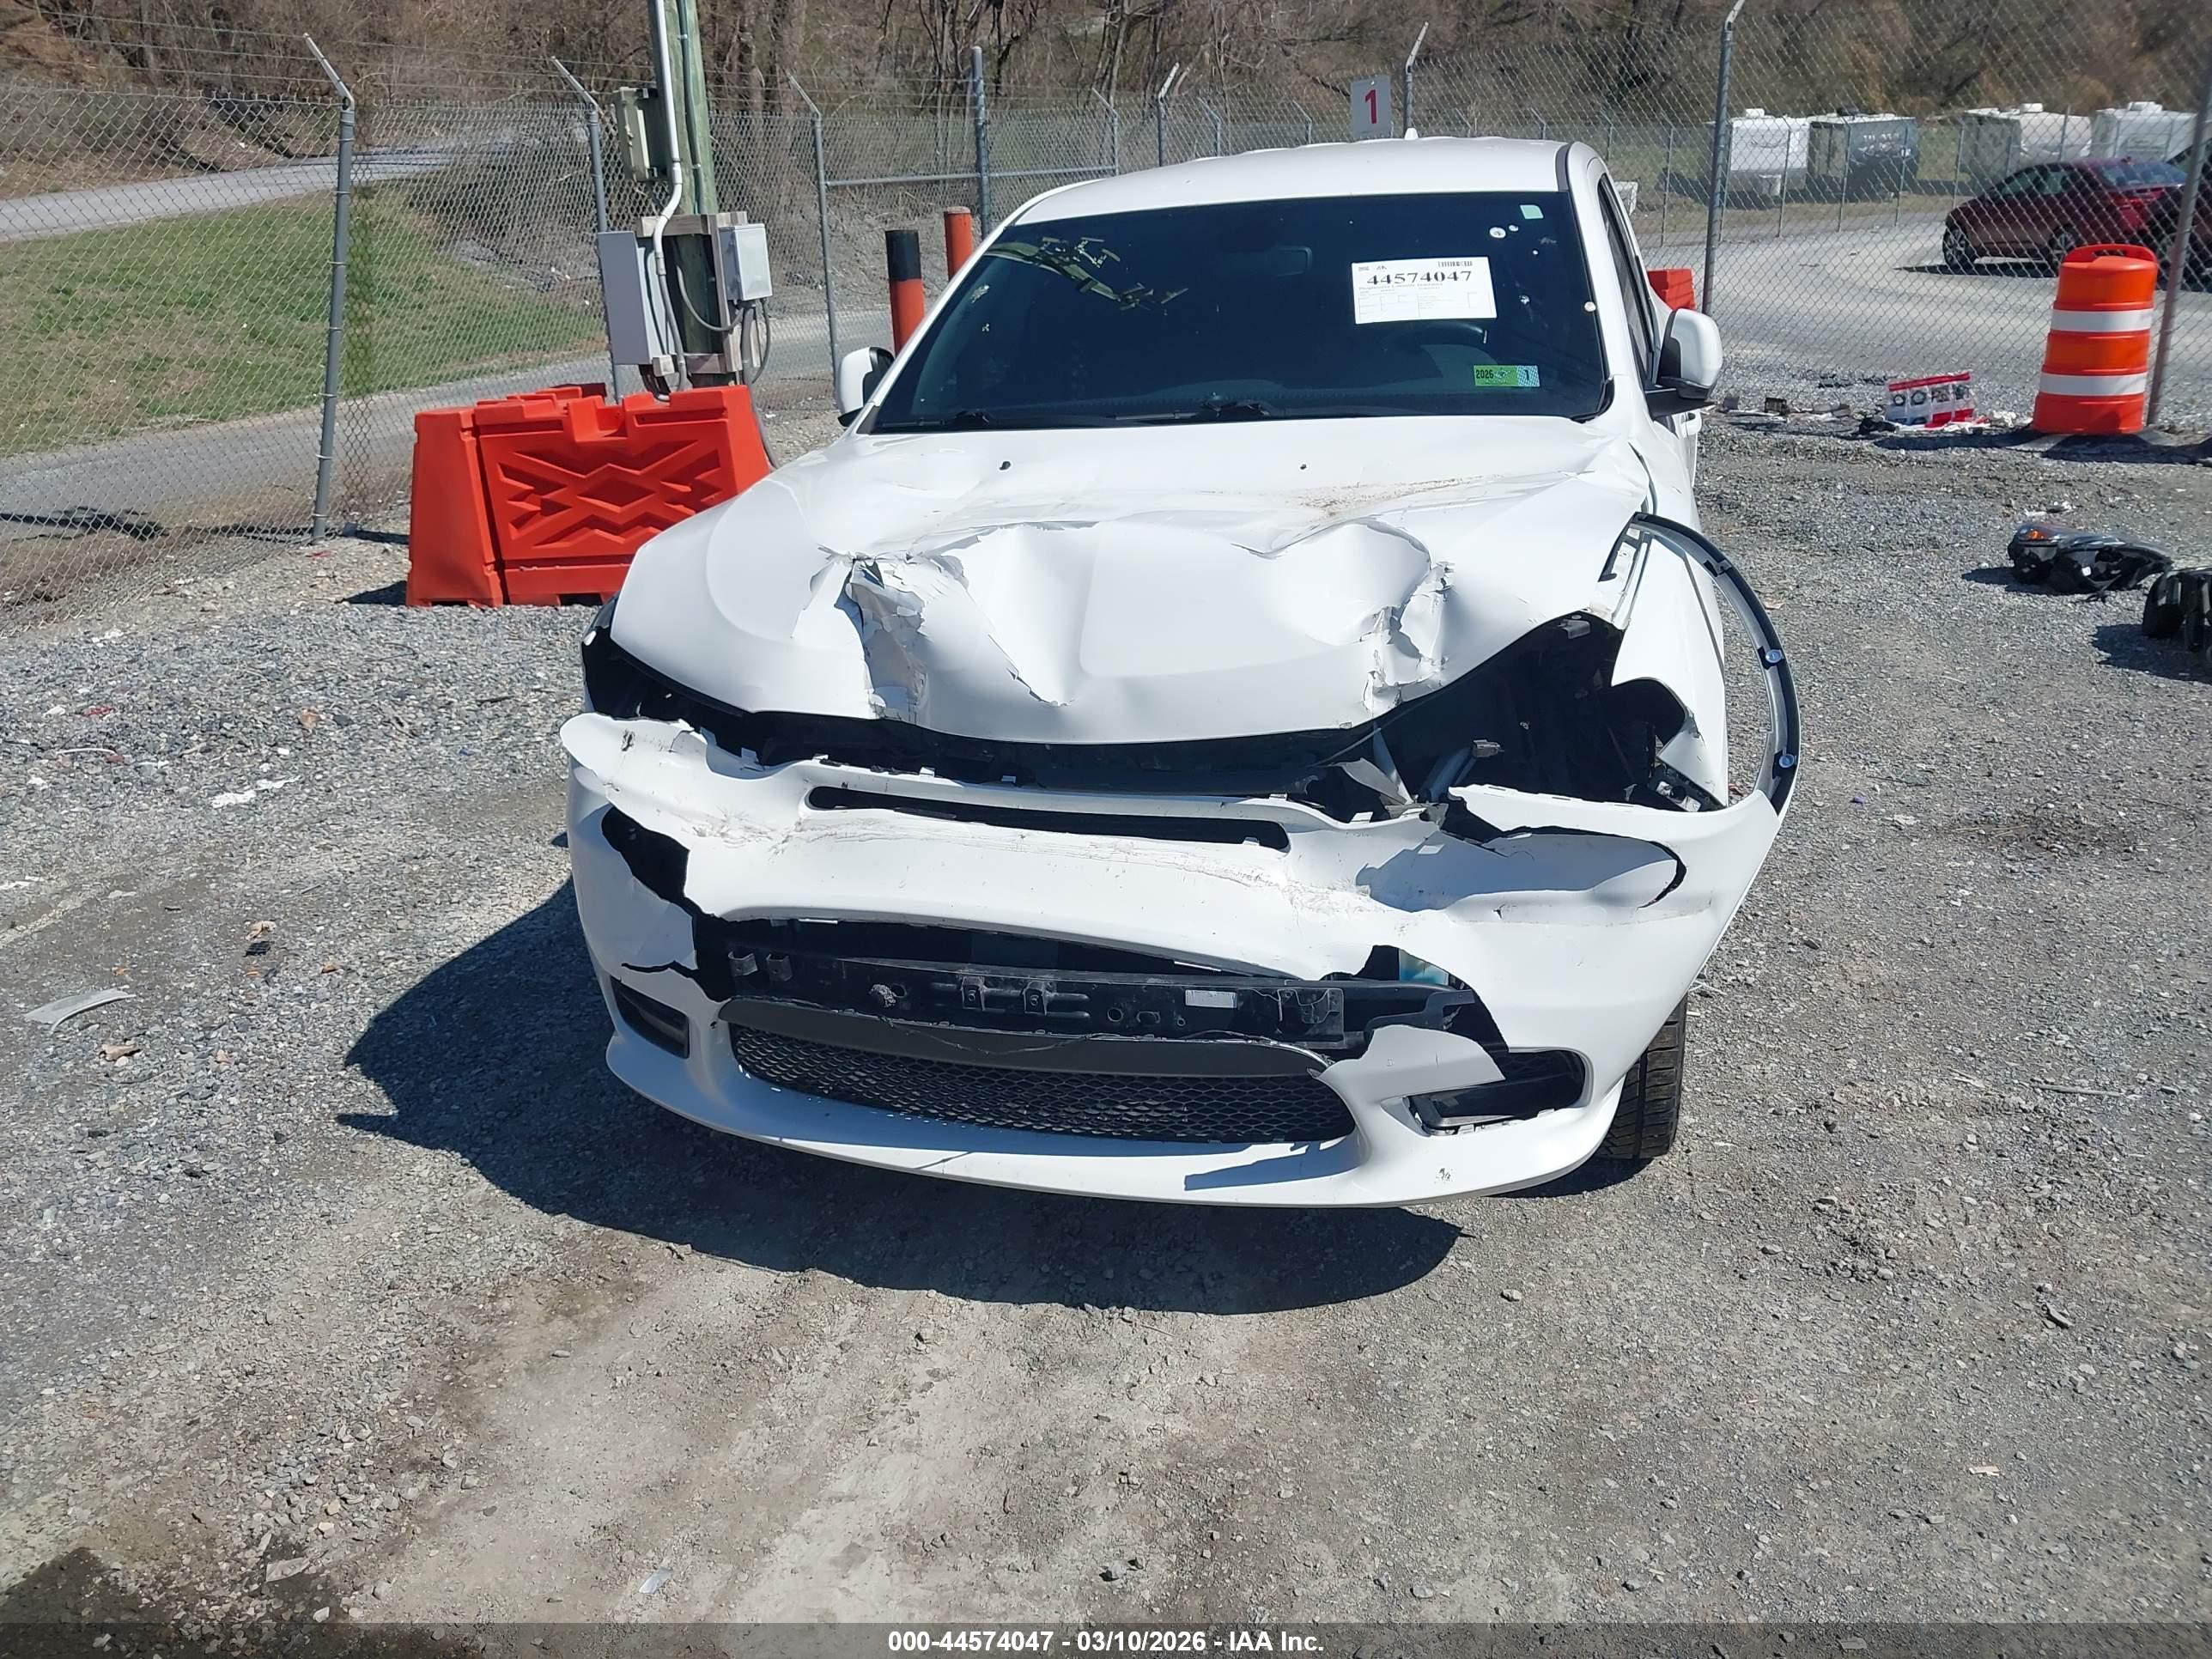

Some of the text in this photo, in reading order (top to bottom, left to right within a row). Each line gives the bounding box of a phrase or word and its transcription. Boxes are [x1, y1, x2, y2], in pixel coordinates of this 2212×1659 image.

[1365, 88, 1377, 125] 1
[1366, 270, 1472, 286] 44574047
[1475, 369, 1494, 380] 2026
